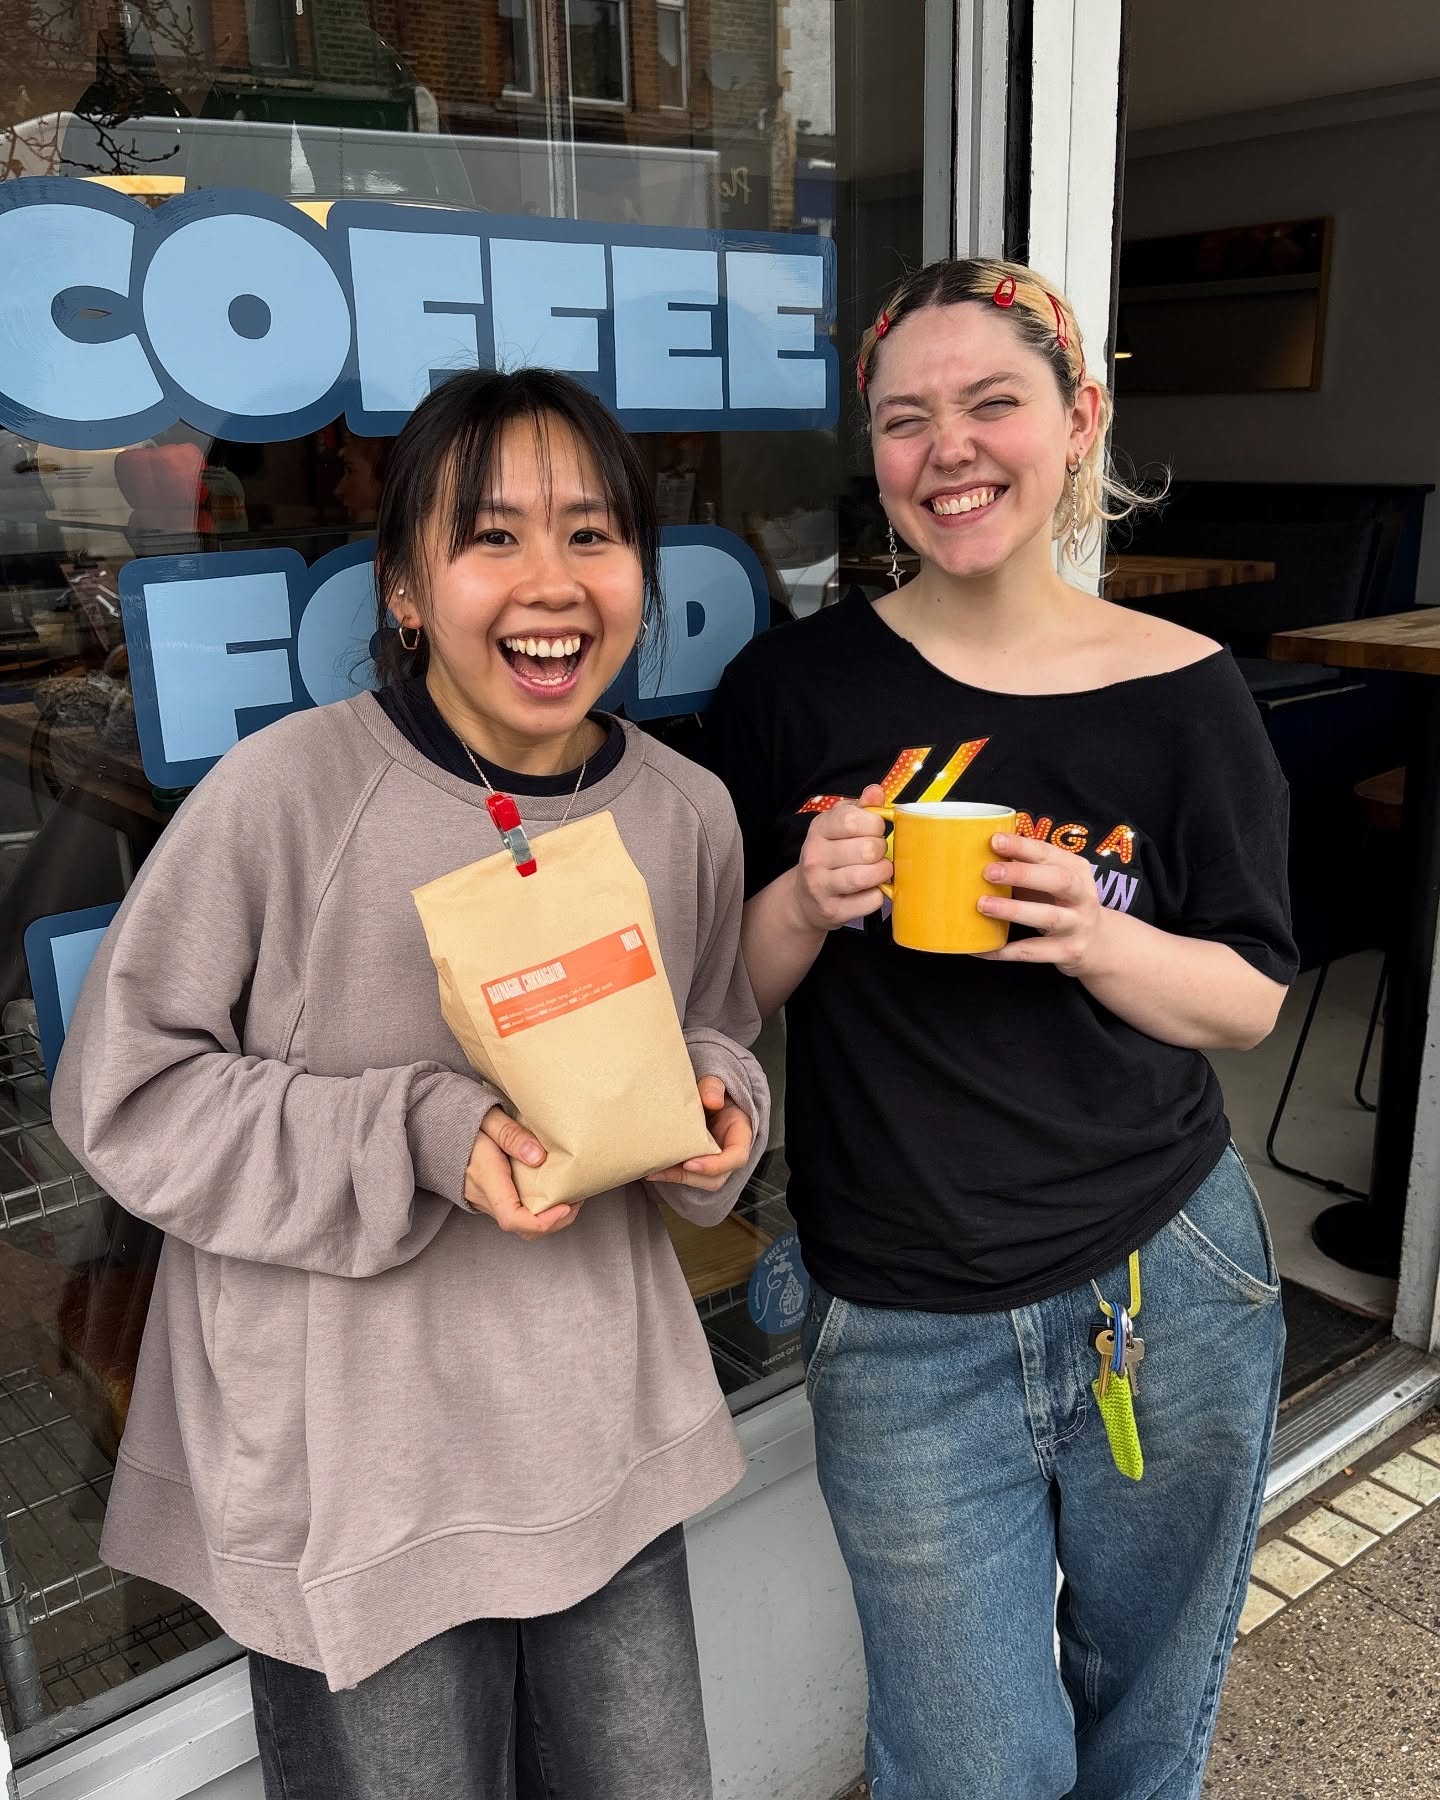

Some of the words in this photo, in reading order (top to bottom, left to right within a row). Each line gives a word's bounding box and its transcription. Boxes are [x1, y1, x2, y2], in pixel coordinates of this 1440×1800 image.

[0, 203, 828, 421] COFFEE
[143, 543, 757, 763] FD
[1095, 823, 1134, 864] A
[763, 1243, 781, 1265] FREE
[779, 1310, 806, 1328] LONDON
[761, 1351, 786, 1367] MAYOR
[785, 1345, 796, 1355] OF
